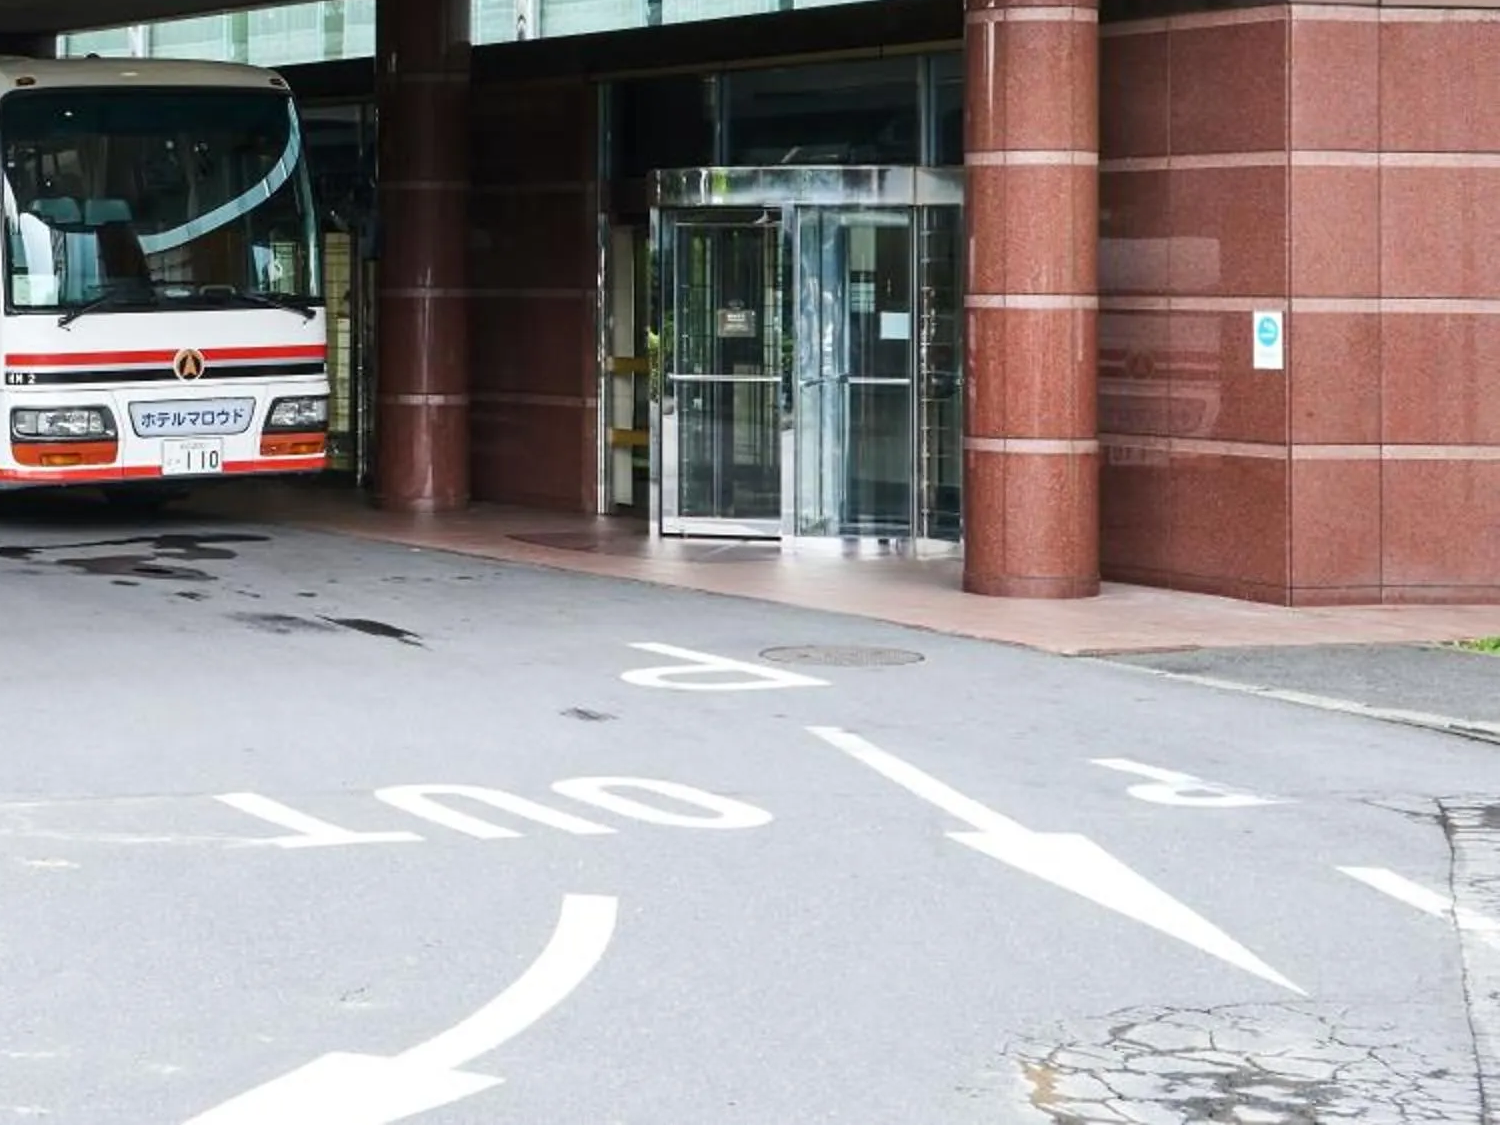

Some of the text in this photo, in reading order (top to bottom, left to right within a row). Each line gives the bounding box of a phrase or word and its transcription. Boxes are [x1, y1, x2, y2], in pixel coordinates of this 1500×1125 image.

[141, 408, 244, 428] ホテルマロウド
[186, 450, 219, 470] 110
[212, 775, 773, 849] OUT
